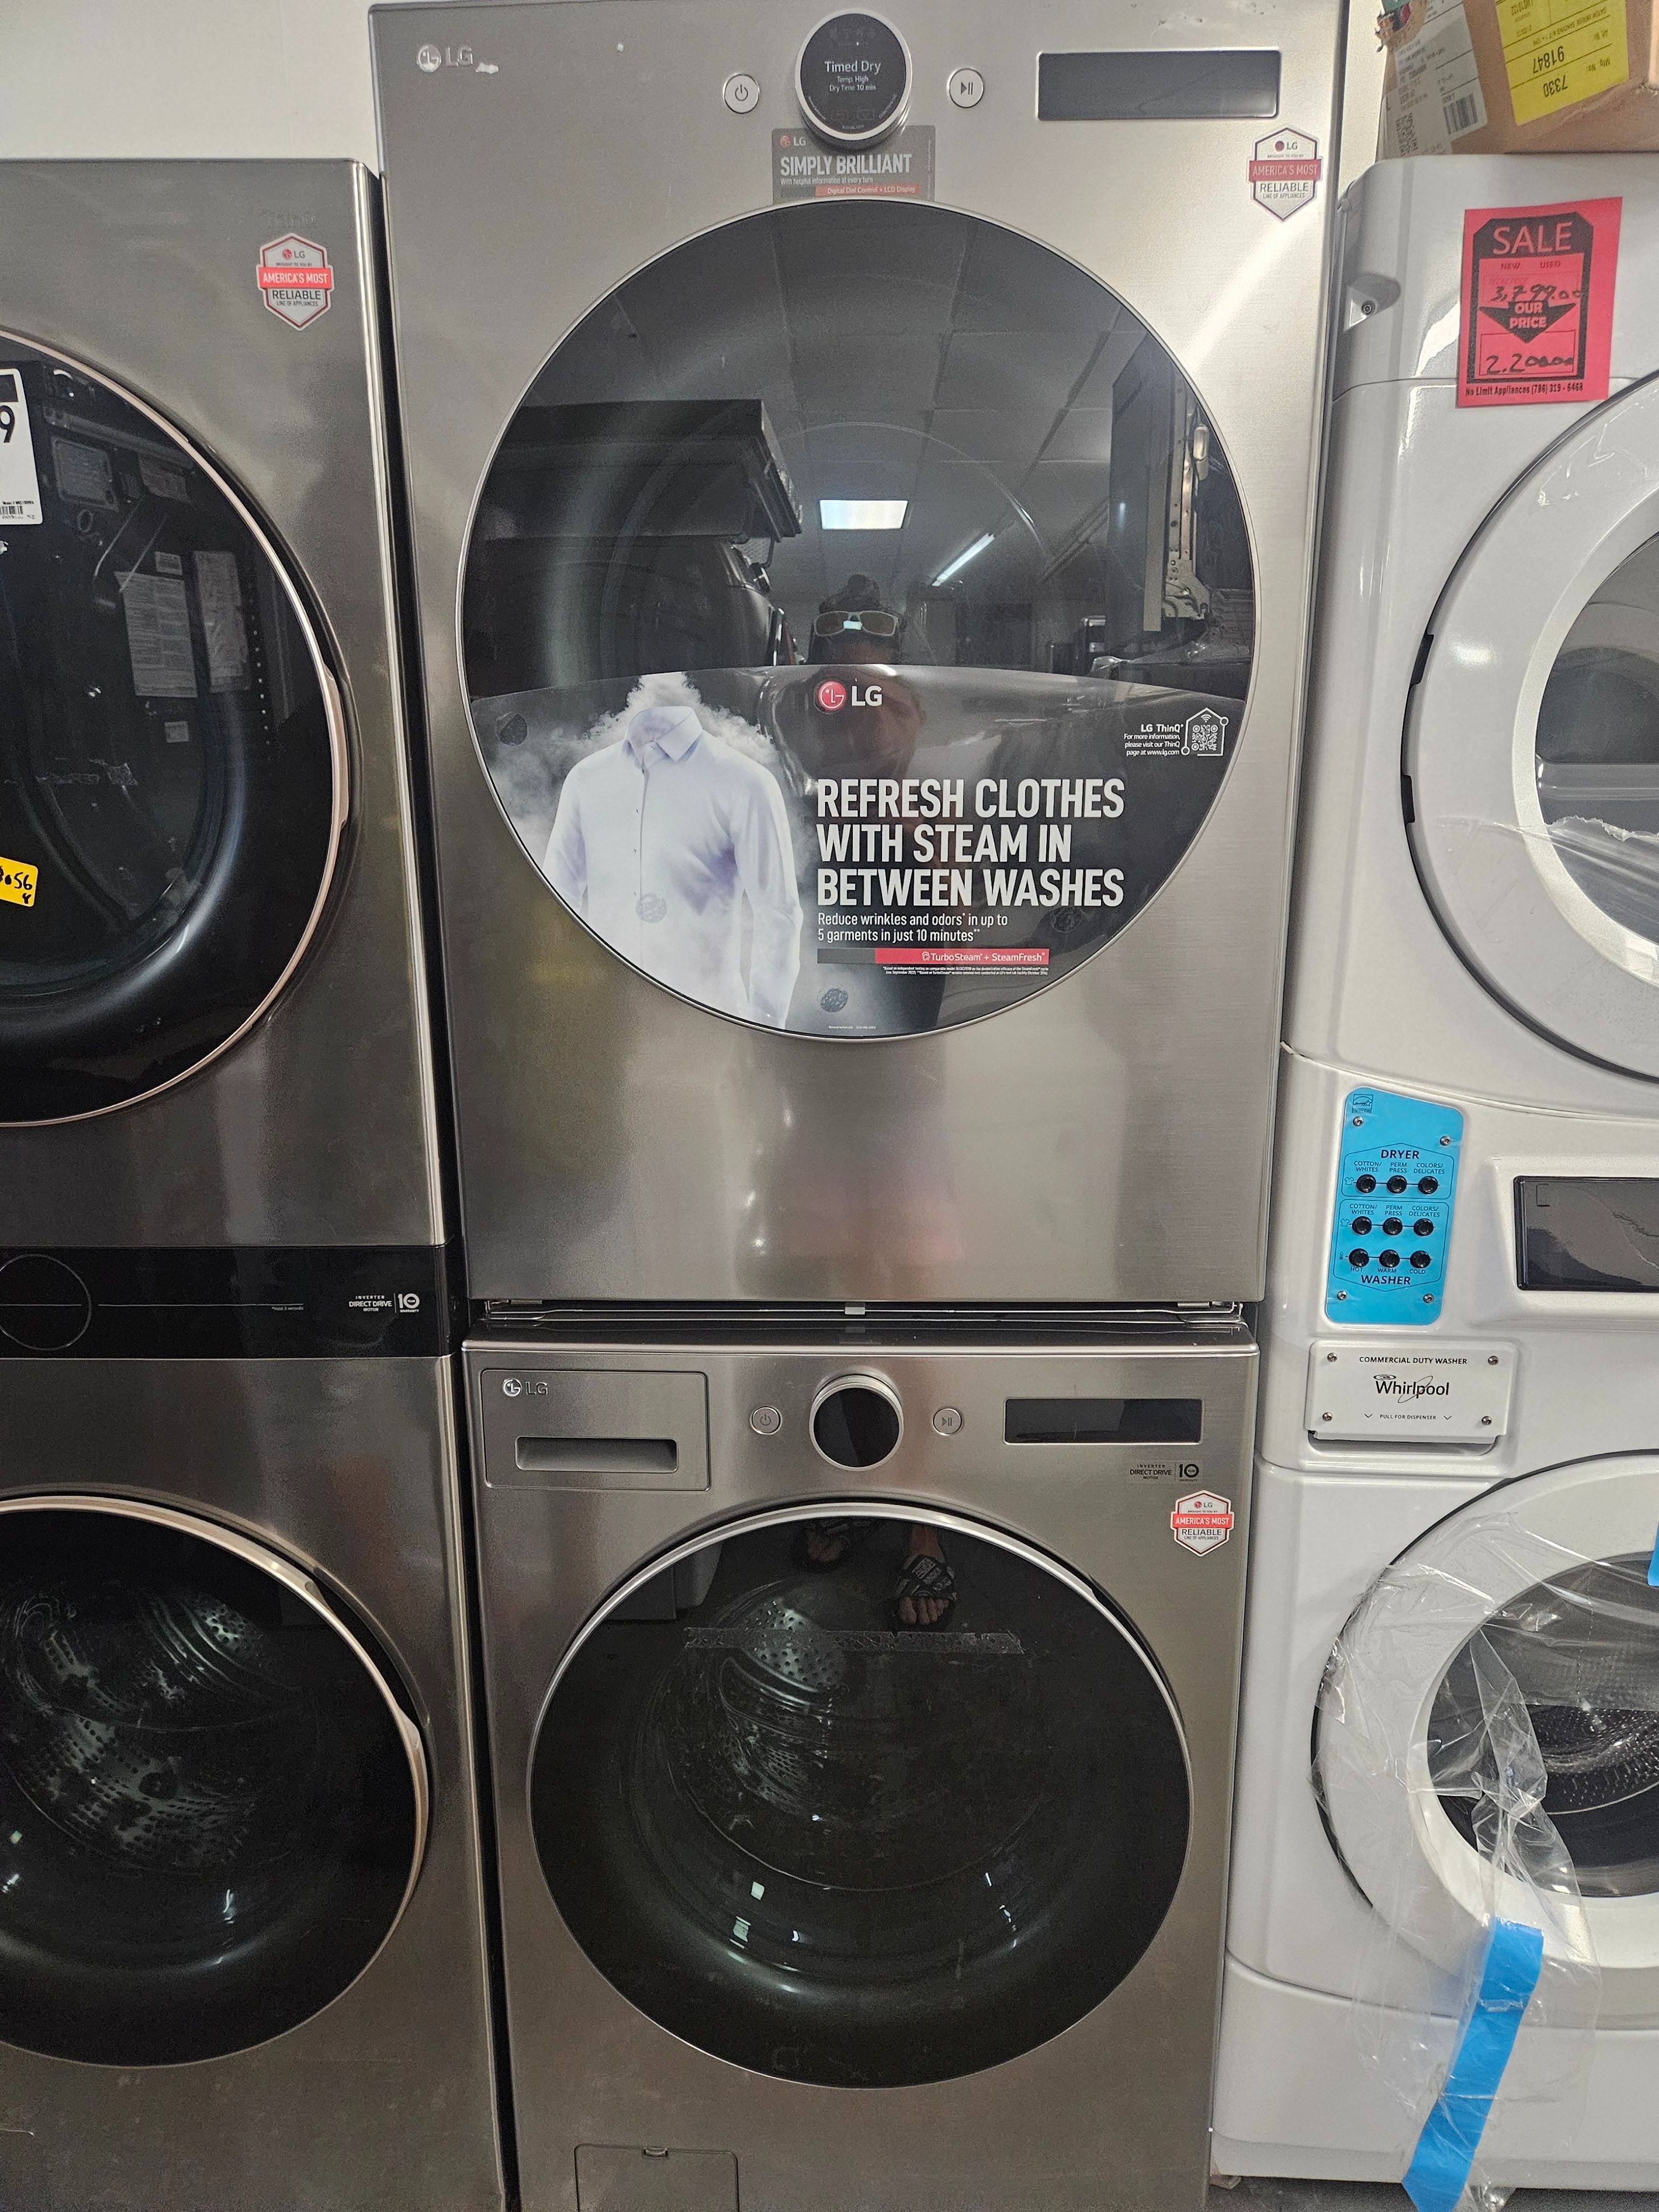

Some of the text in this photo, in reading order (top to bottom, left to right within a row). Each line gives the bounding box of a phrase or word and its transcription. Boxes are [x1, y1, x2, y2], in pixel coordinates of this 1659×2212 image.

[445, 46, 473, 66] LG
[1532, 45, 1564, 74] 91847
[824, 60, 881, 75] Timed Dry
[830, 85, 839, 93] Dry
[1543, 75, 1569, 97] 7330
[794, 137, 806, 146] LG
[1286, 142, 1298, 150] LG
[780, 154, 912, 176] SIMPLY BRILLIANT
[1253, 164, 1318, 176] AMERICA'S MOST
[827, 187, 846, 195] Digital
[896, 185, 916, 194] Display
[1260, 182, 1309, 192] RELIABLE
[1493, 221, 1573, 255] SALE
[294, 251, 306, 259] LG
[1540, 260, 1561, 269] USED
[263, 273, 328, 284] AMERICA'S MOST
[272, 290, 321, 300] RELIABLE
[1514, 302, 1543, 315] OUR
[1509, 316, 1547, 328] PRICE
[1465, 387, 1474, 397] No
[1476, 386, 1493, 396] Limit
[1494, 385, 1530, 397] Appliances
[851, 685, 883, 707] LG
[1140, 723, 1154, 733] LG
[1147, 749, 1180, 757] www.lg.com
[817, 778, 1125, 818] REFRESH CLOTHES
[816, 823, 1072, 863] WITH STEAM IN
[817, 868, 1125, 907] BETWEEN WASHES
[818, 912, 858, 926] Reduce
[860, 912, 907, 926] wrinkles
[909, 913, 929, 926] and
[968, 913, 978, 926] in
[980, 915, 994, 928] up
[997, 914, 1008, 926] to
[818, 928, 824, 941] 5
[827, 929, 878, 943] garments
[881, 928, 890, 941] in
[892, 928, 914, 943] just
[916, 928, 927, 941] 10
[1381, 1149, 1420, 1160] DRYER
[1361, 1274, 1411, 1285] WASHER
[398, 1293, 420, 1309] 10
[1359, 1356, 1411, 1364] COMMERCIAL
[525, 1381, 548, 1395] LG
[1375, 1381, 1449, 1399] Whirlpool
[1178, 1463, 1199, 1478] 10
